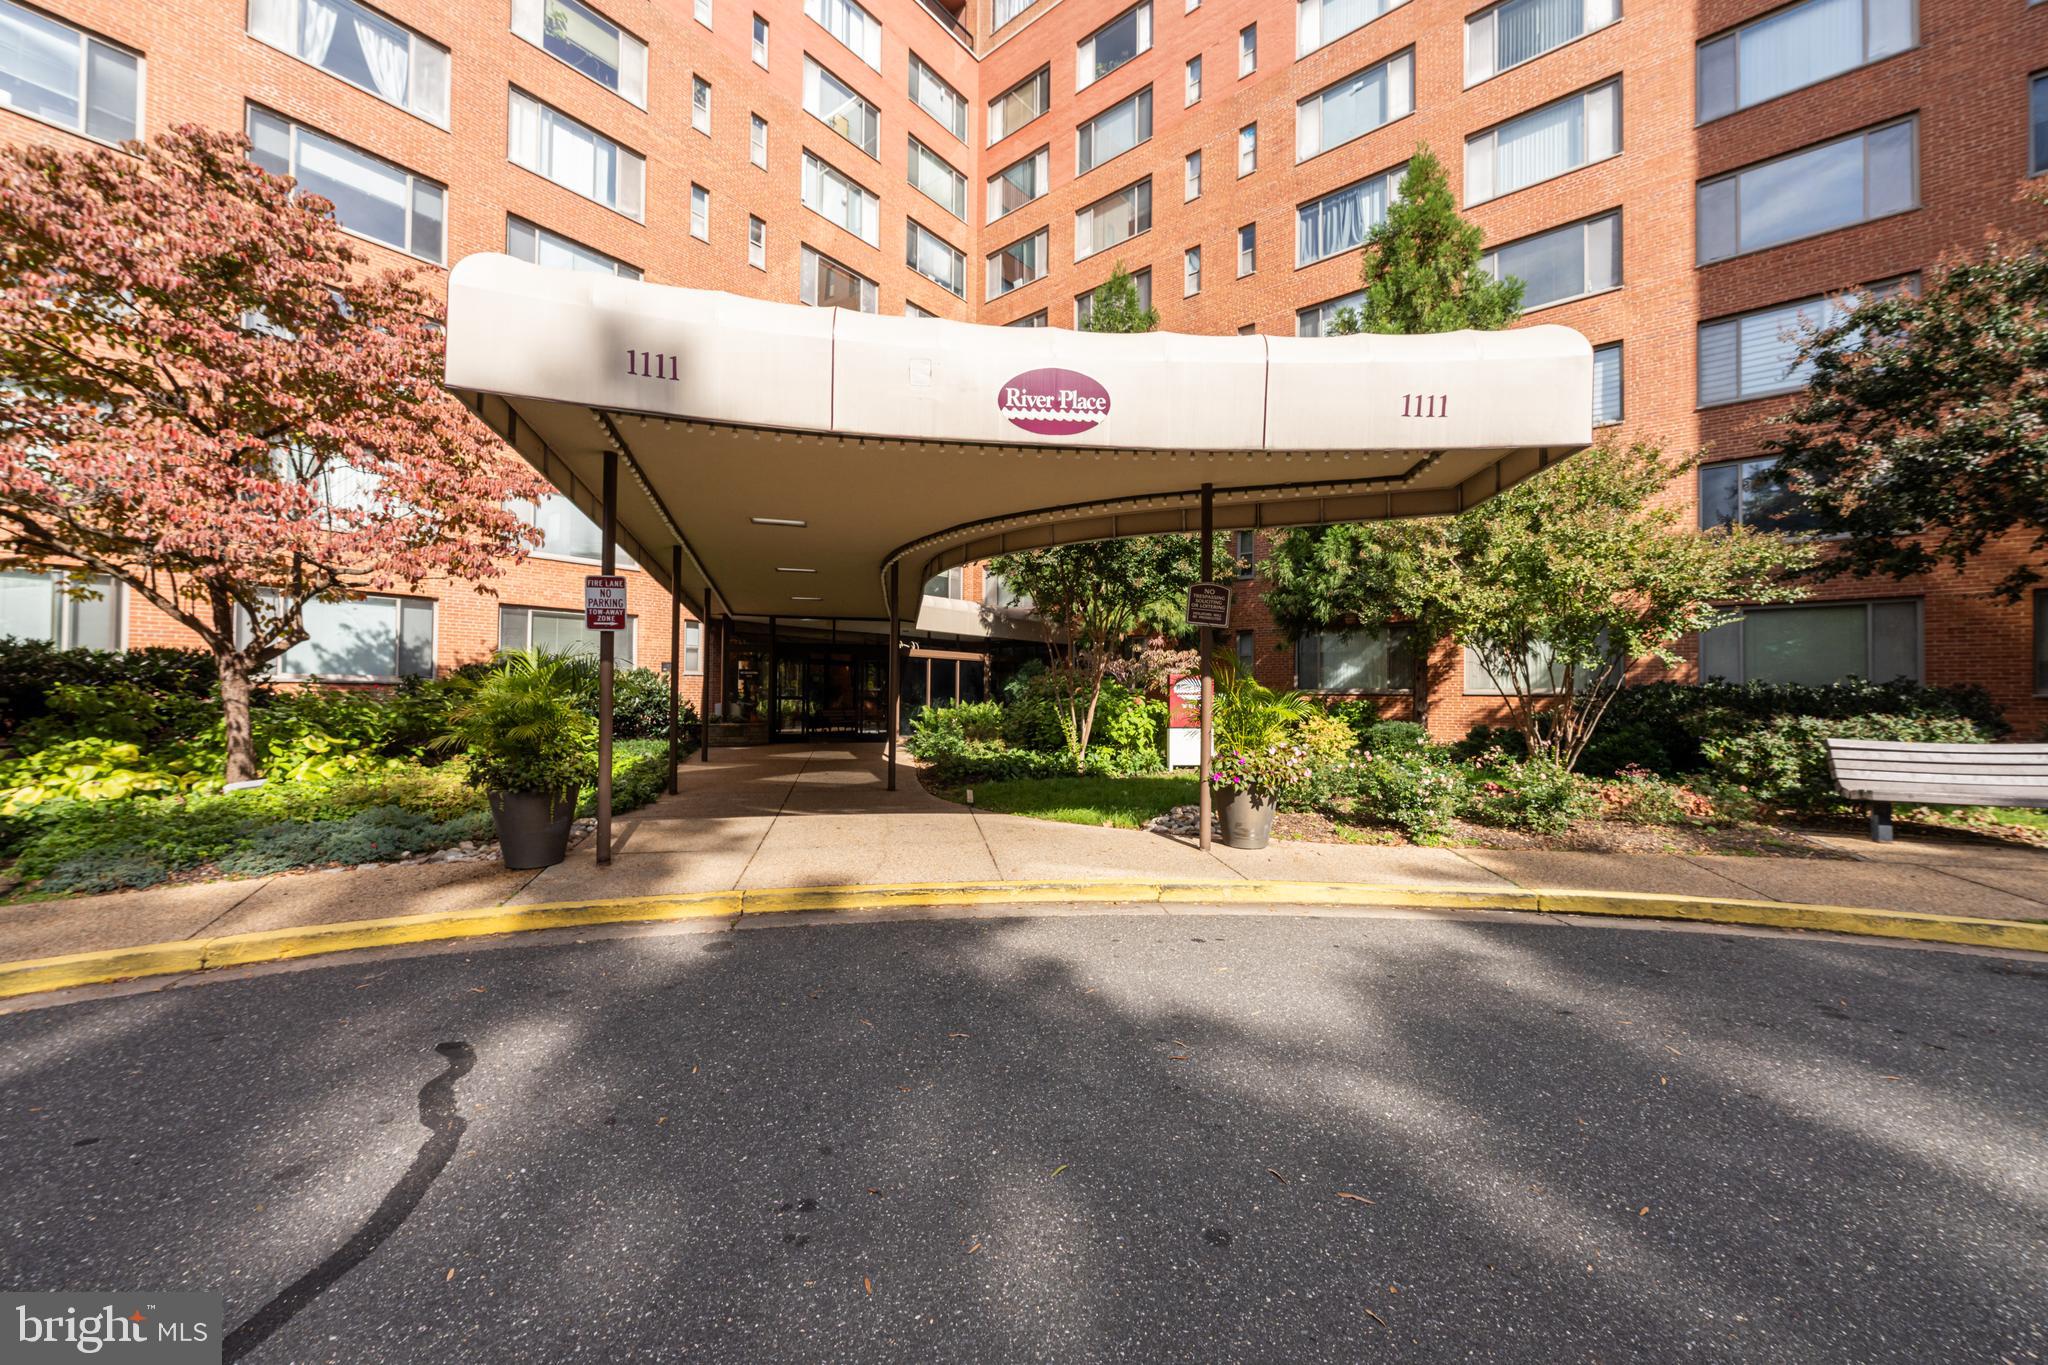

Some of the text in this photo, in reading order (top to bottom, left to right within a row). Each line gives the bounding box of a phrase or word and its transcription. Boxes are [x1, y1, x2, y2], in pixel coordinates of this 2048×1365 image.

[626, 349, 680, 381] 1111
[1005, 387, 1107, 411] River Place
[1401, 393, 1449, 418] 1111
[588, 598, 624, 608] PARKING
[600, 589, 612, 598] NO
